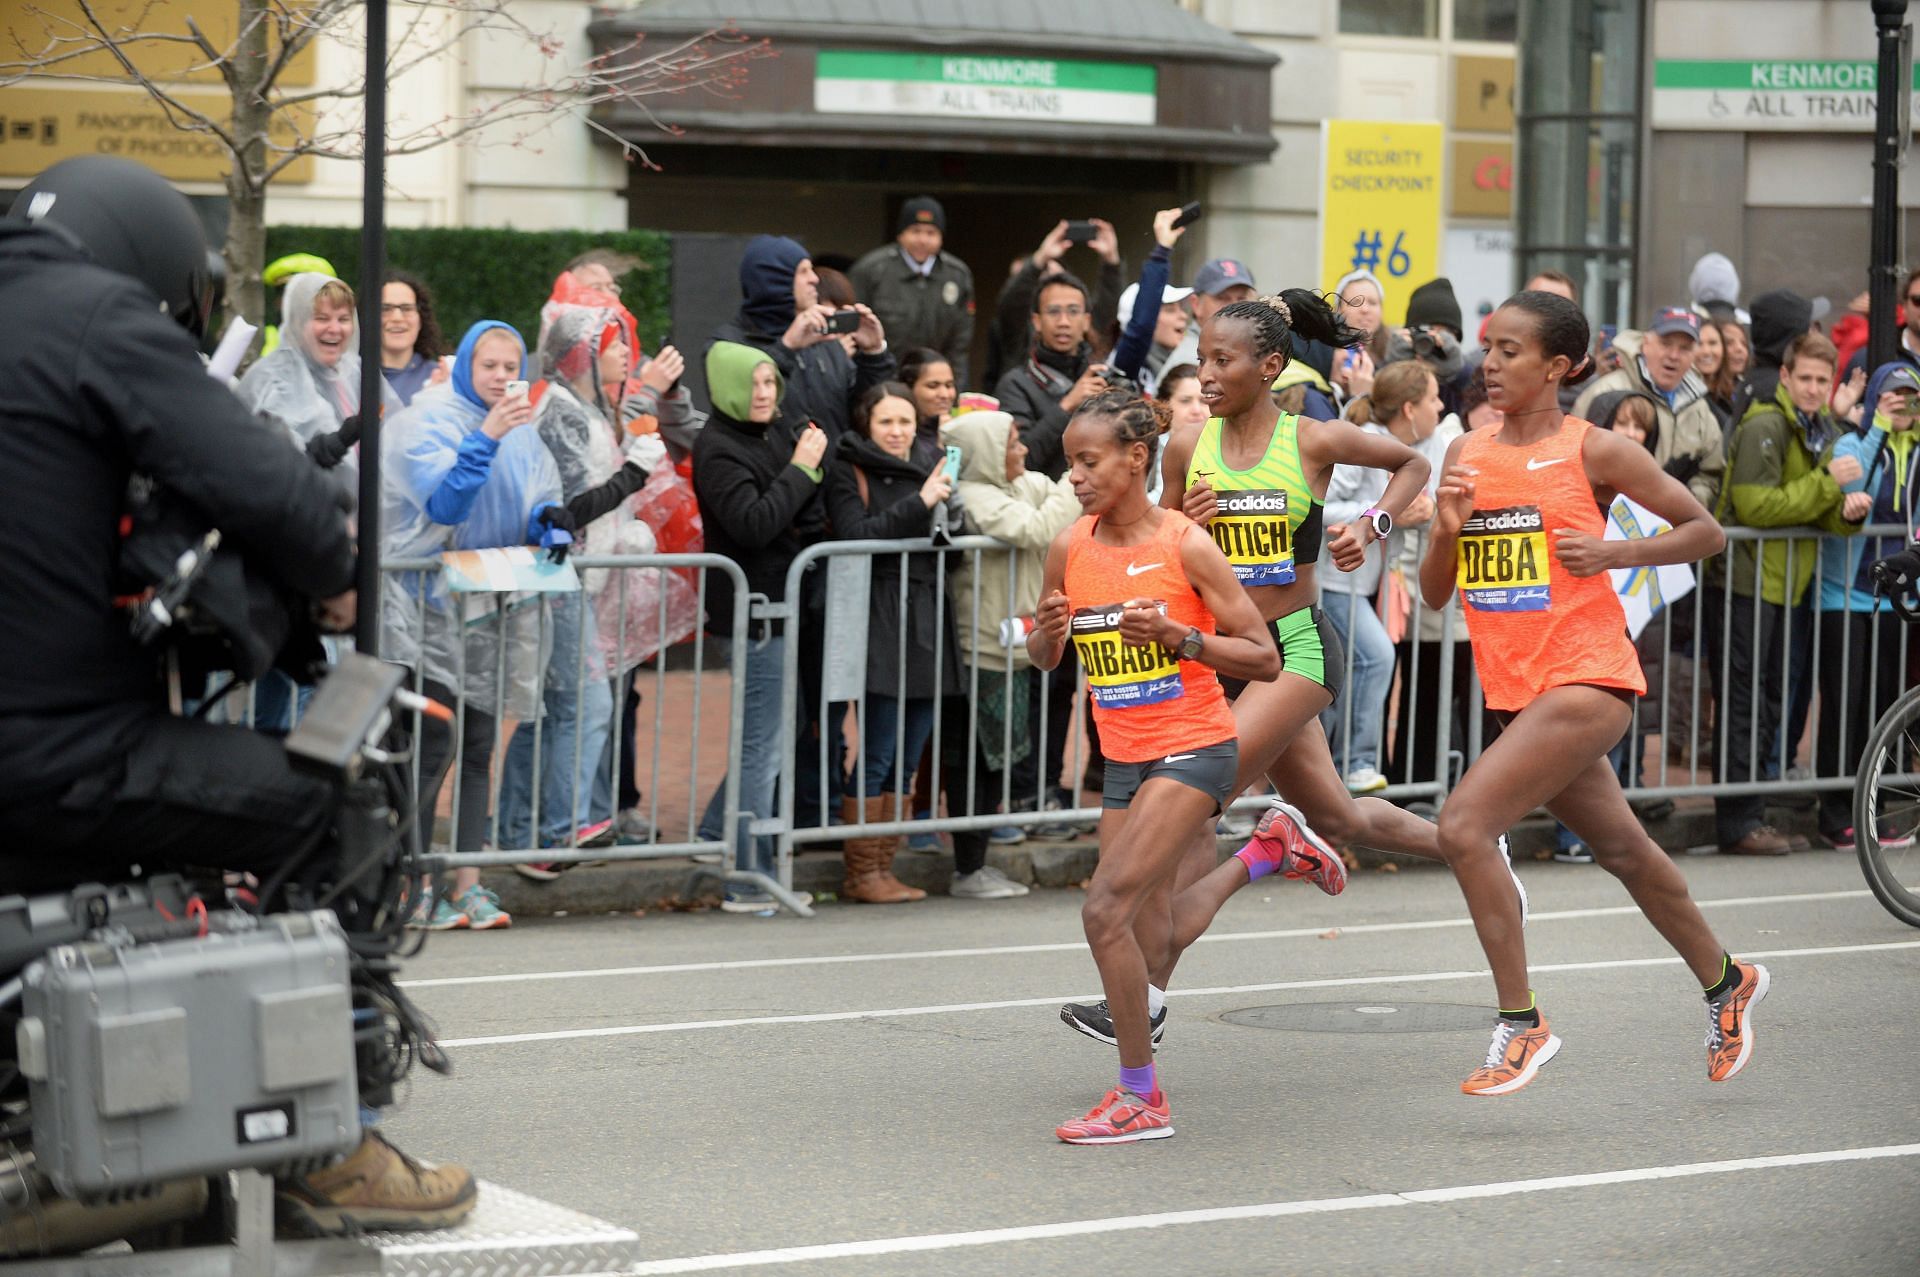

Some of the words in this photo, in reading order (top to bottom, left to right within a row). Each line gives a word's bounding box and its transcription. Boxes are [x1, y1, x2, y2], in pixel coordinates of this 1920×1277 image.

[943, 60, 1058, 85] KENMORE
[1751, 63, 1876, 88] KENMOR
[940, 89, 978, 111] ALL
[988, 92, 1061, 114] TRAINS
[1745, 95, 1795, 117] ALL
[1804, 95, 1878, 117] TRAIN
[1345, 150, 1423, 166] SECURITY
[1330, 174, 1433, 191] CHECKPOINT
[1351, 231, 1411, 278] #6
[1229, 494, 1286, 511] adidas
[1485, 512, 1541, 530] adidas
[1463, 537, 1538, 583] DEBA
[1078, 640, 1178, 678] DIBABA
[1103, 692, 1141, 701] MARATHON
[1114, 685, 1139, 694] BOSTON
